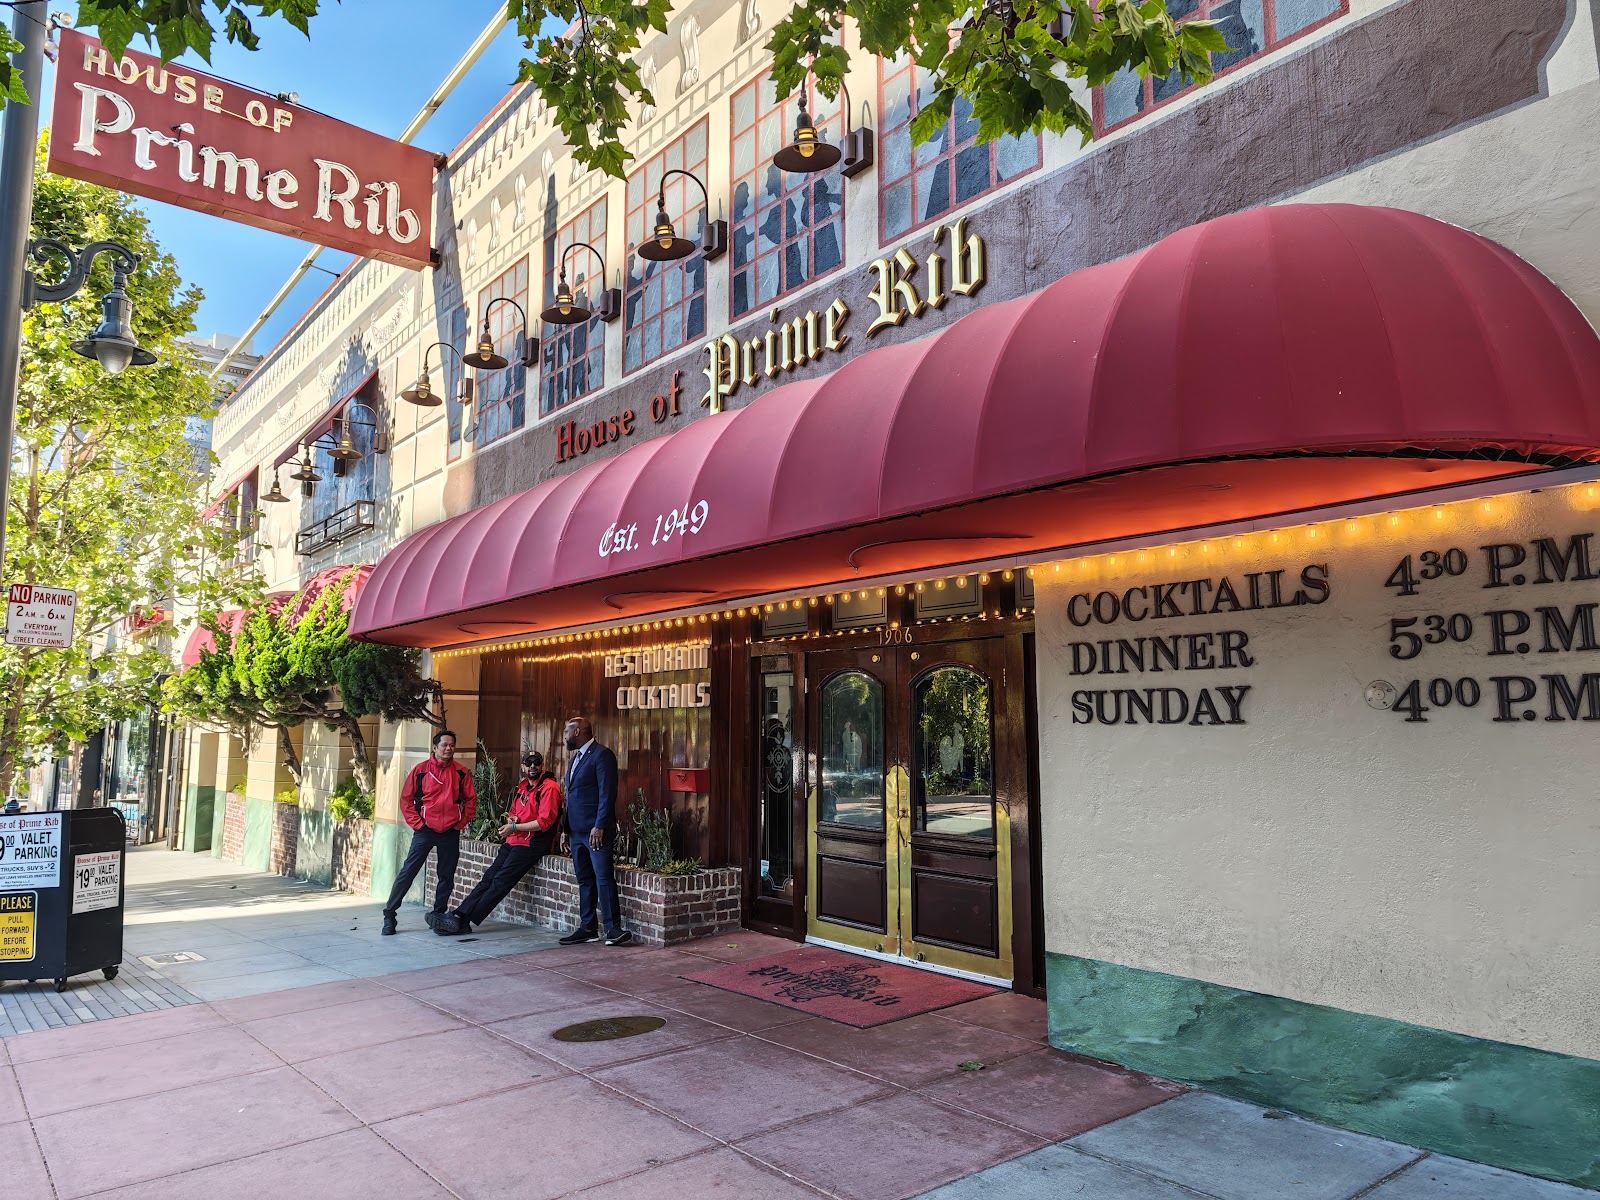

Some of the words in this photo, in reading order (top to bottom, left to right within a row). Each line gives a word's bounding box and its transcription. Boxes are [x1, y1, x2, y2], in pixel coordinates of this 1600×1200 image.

[83, 44, 224, 113] HOUSE
[246, 100, 293, 133] OF
[73, 82, 298, 209] Prime
[312, 158, 420, 243] Rib
[555, 406, 634, 464] House
[649, 369, 682, 424] of
[700, 297, 850, 415] Prime
[866, 216, 985, 338] Rib
[599, 522, 639, 557] Est.
[651, 499, 709, 546] 1949
[1066, 563, 1331, 626] COCKTAILS
[1480, 533, 1600, 588] P.M
[12, 586, 30, 602] NO
[33, 591, 73, 606] PARKING
[24, 623, 57, 631] EVERYDAY
[13, 636, 34, 644] STREET
[36, 637, 65, 646] CLEANING
[878, 626, 912, 645] 1906
[605, 644, 711, 677] RESTAURANT
[1068, 630, 1254, 676] DINNER
[617, 682, 711, 710] COCKTAILS
[1072, 686, 1251, 725] SUNDAY
[8, 820, 16, 829] of
[18, 819, 42, 830] Prime
[44, 817, 59, 827] Rib
[21, 831, 52, 846] VALET
[14, 845, 58, 860] PARKING
[98, 864, 115, 875] VALET
[95, 874, 118, 887] PARKING
[1, 896, 32, 910] PLEASE
[8, 916, 23, 924] PULL
[1, 926, 30, 934] FORWARD
[3, 937, 27, 945] BEFORE
[0, 946, 30, 956] STOPPING
